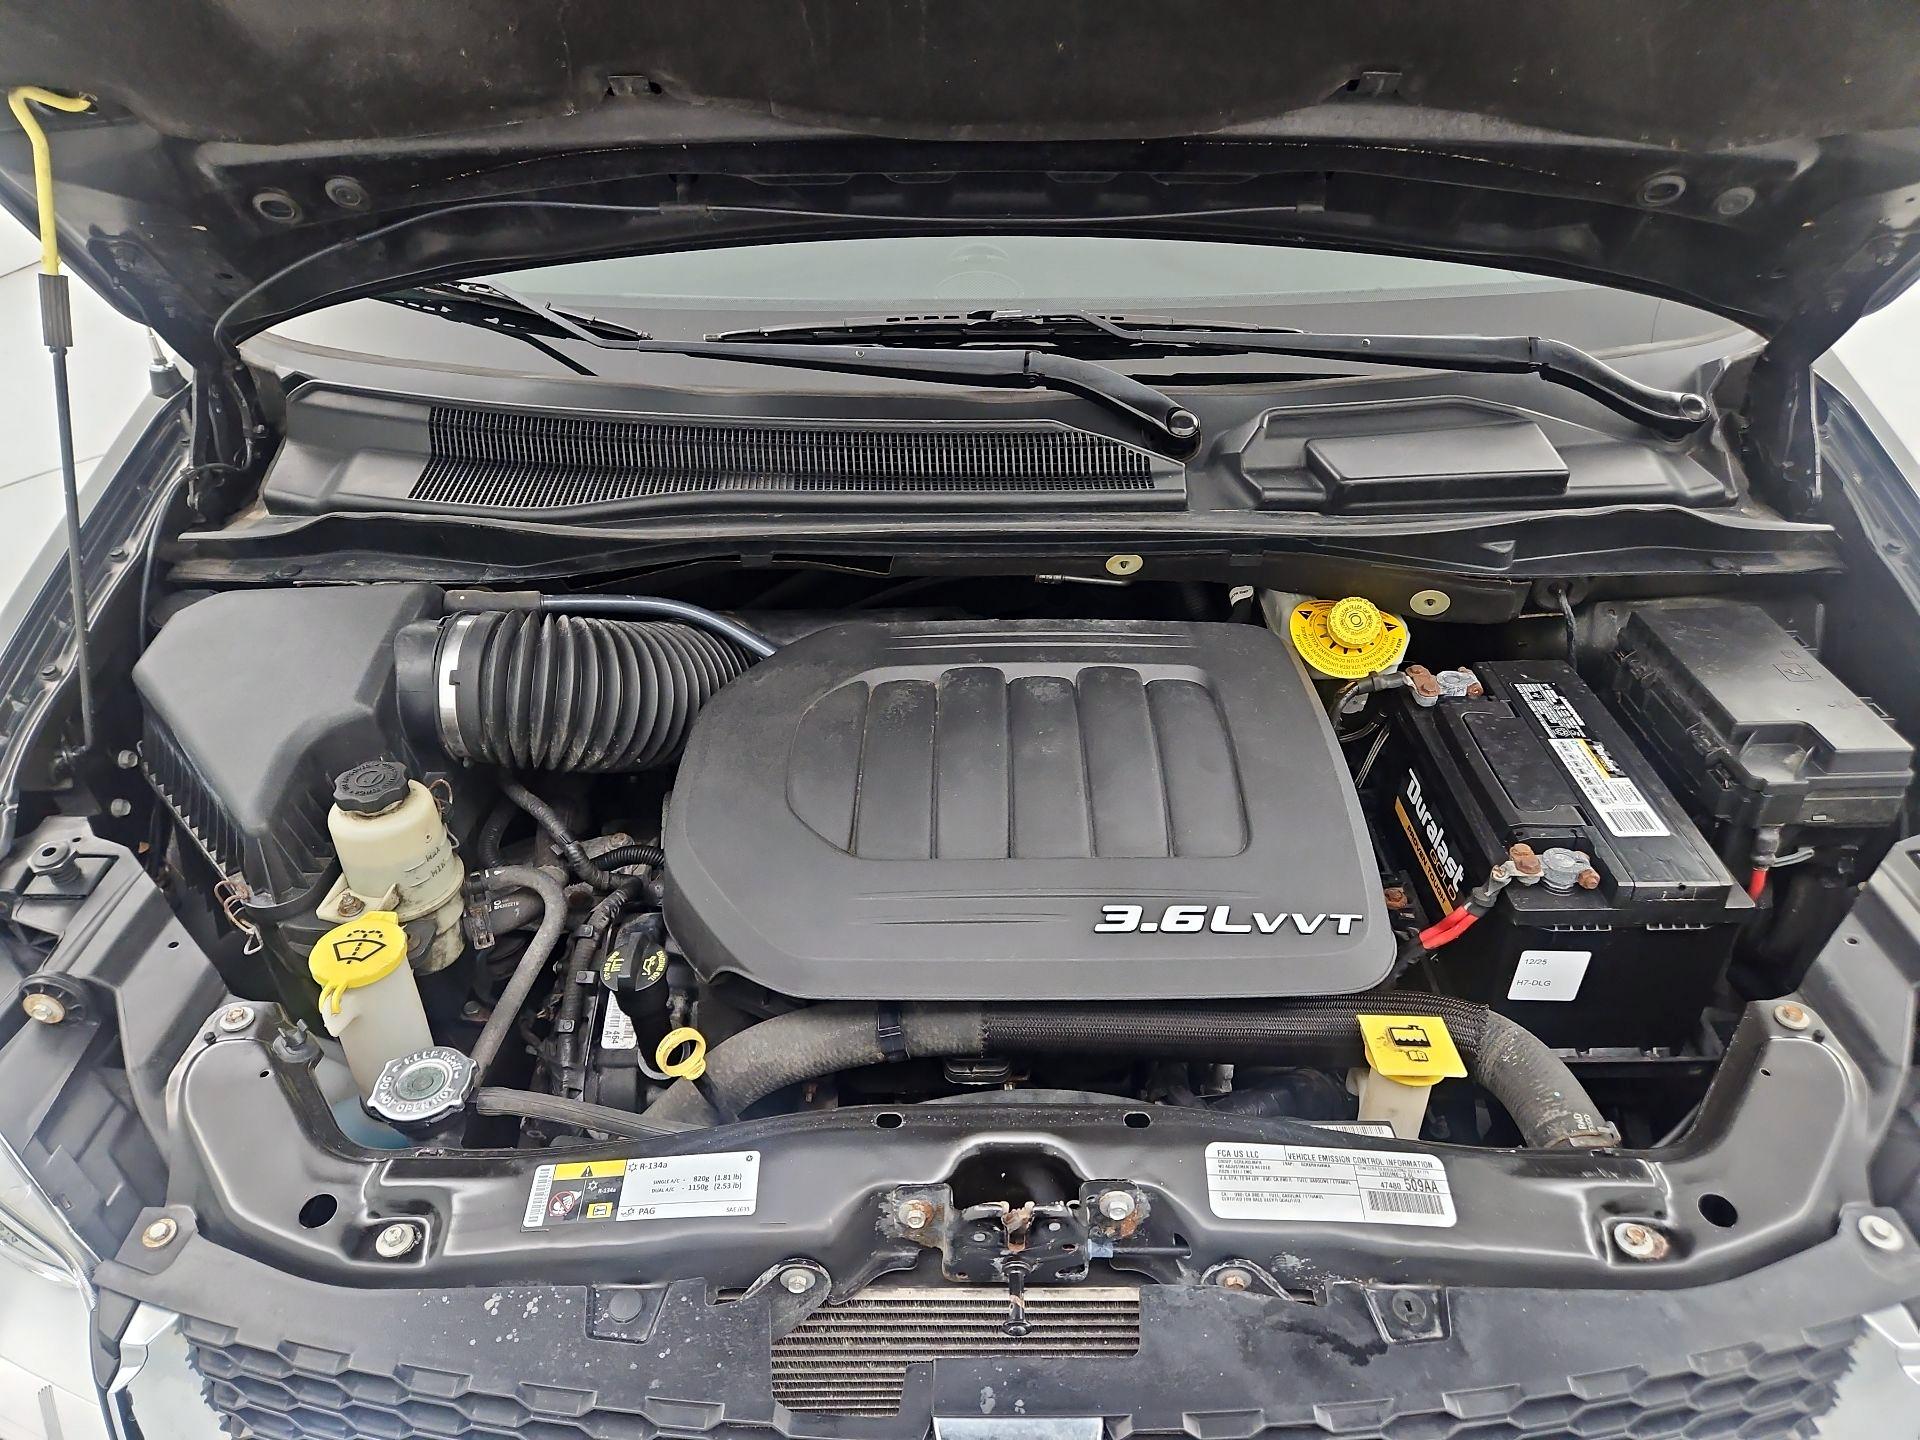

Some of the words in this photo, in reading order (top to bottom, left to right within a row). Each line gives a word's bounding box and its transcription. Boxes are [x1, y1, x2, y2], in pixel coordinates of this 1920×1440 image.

[1406, 767, 1464, 893] Duralast
[1406, 825, 1428, 865] PROVEN
[1427, 866, 1446, 903] TOUGH
[1429, 848, 1457, 901] GOLD
[1252, 912, 1364, 935] VVT
[656, 950, 666, 972] ENGINE
[648, 971, 660, 981] OIL
[611, 1030, 620, 1044] 464
[1217, 1150, 1231, 1158] FCA
[1234, 1150, 1244, 1158] US
[1287, 1152, 1316, 1161] VEHICLE
[1318, 1154, 1351, 1164] EMISSION
[1353, 1156, 1385, 1166] CONTROL
[1386, 1159, 1433, 1169] INFORMATION
[639, 1162, 668, 1170] R-134a
[714, 1174, 731, 1182] (1.81
[733, 1173, 742, 1181] lb)
[714, 1182, 731, 1190] (2.53
[732, 1182, 742, 1190] lb)
[1404, 1178, 1440, 1193] 509AA
[638, 1207, 656, 1215] PAG
